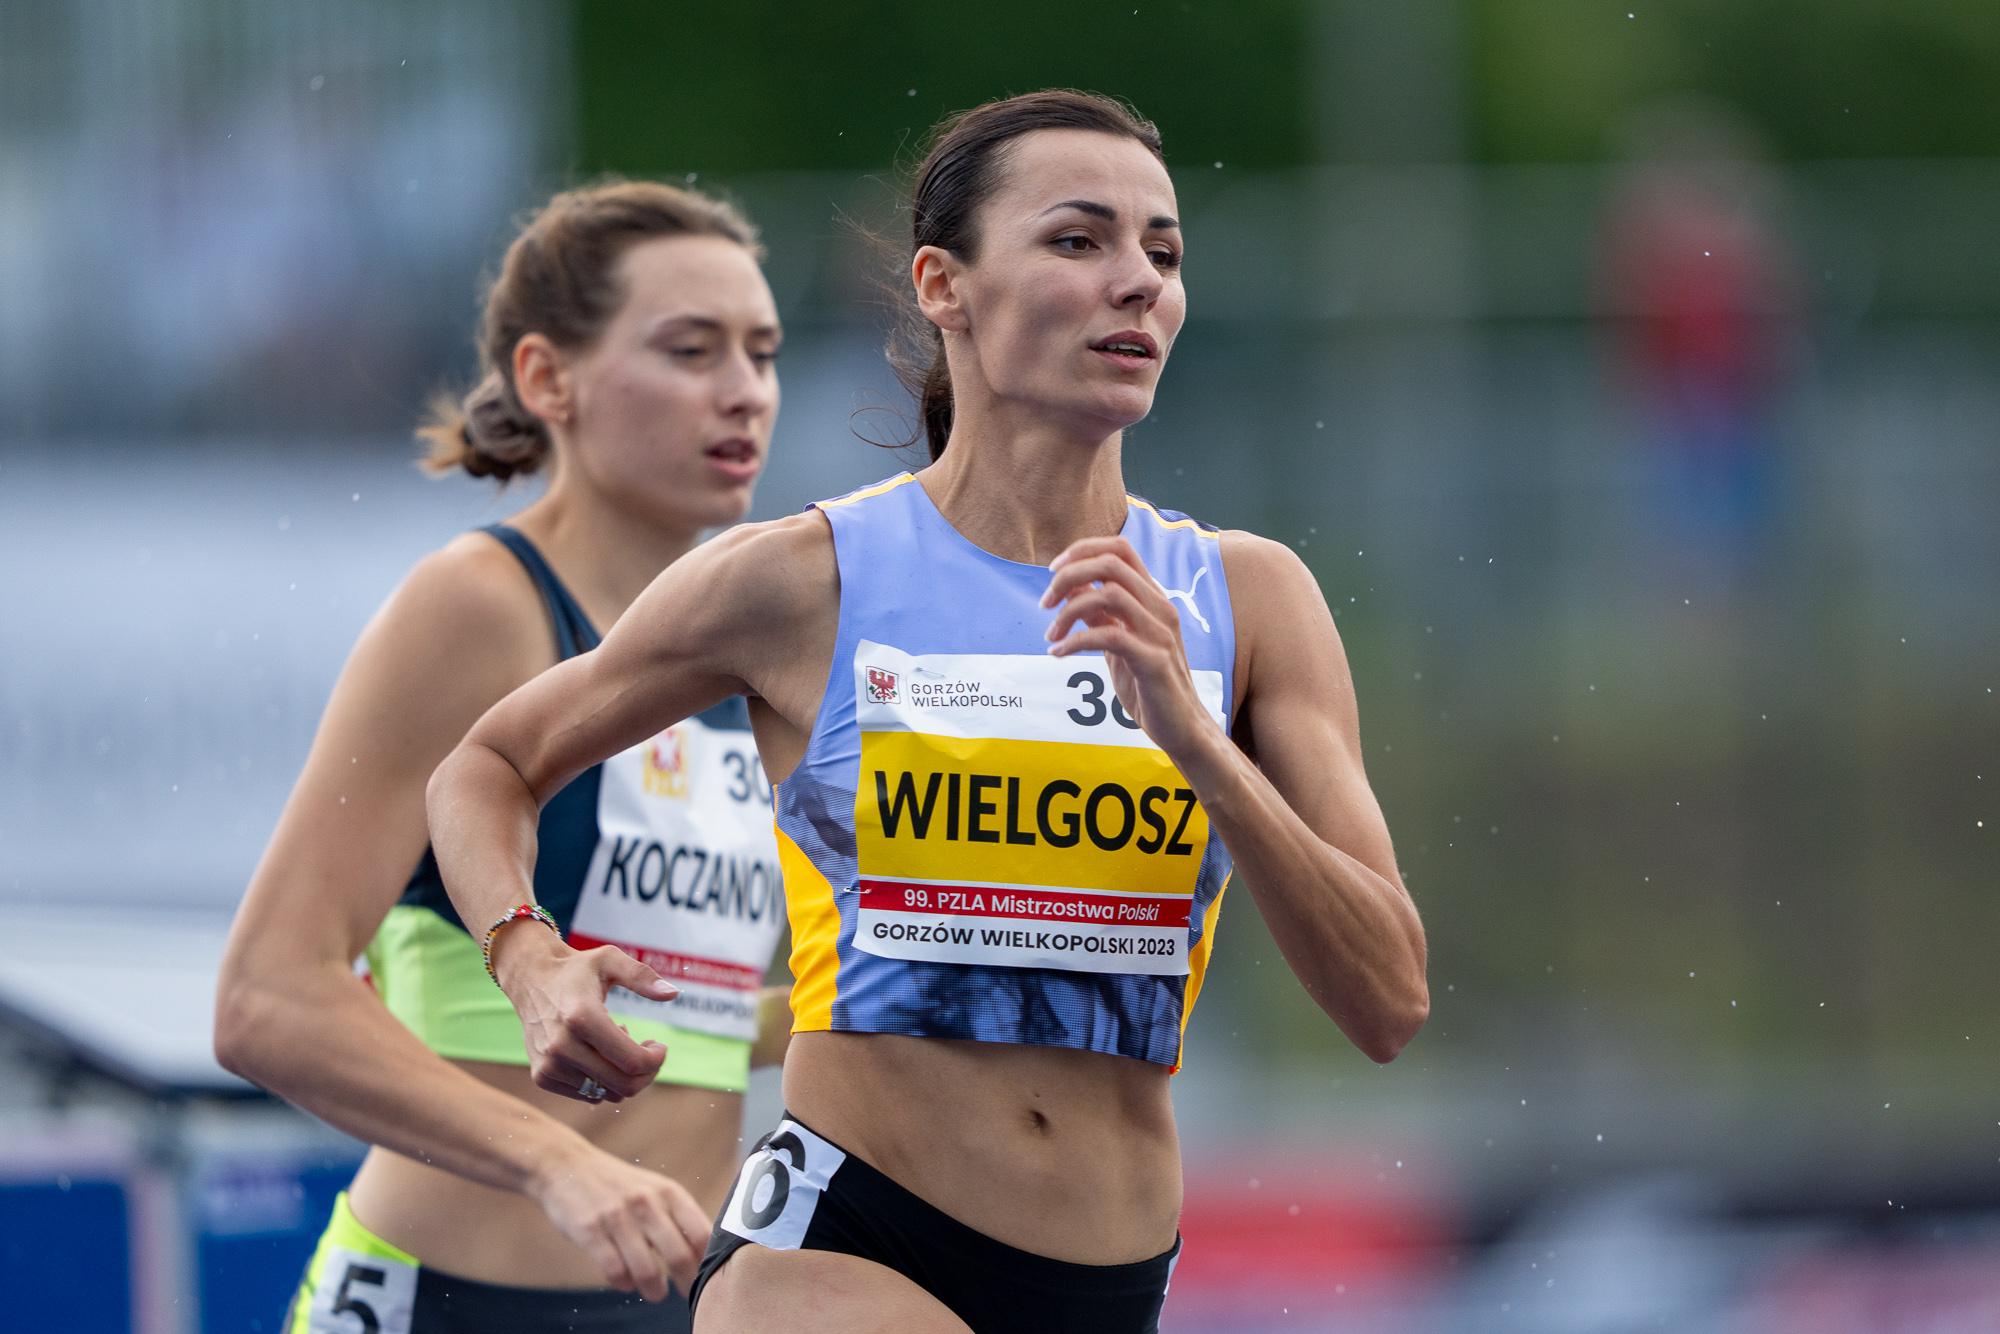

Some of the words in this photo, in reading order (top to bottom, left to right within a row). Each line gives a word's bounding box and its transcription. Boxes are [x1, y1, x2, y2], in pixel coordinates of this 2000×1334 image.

[911, 680, 980, 695] GORZÓW
[911, 694, 1023, 708] WIELKOPOLSKI
[874, 769, 1199, 857] WIELGOSZ
[903, 888, 933, 909] 99.
[937, 892, 986, 912] PZLA
[991, 895, 1114, 920] Mistrzostwa
[1117, 903, 1161, 921] Polski
[873, 921, 975, 945] GORZÓW
[980, 929, 1134, 955] WIELKOPOLSKI
[1137, 937, 1176, 957] 2023
[741, 1129, 806, 1231] 6
[331, 1262, 387, 1334] 5
